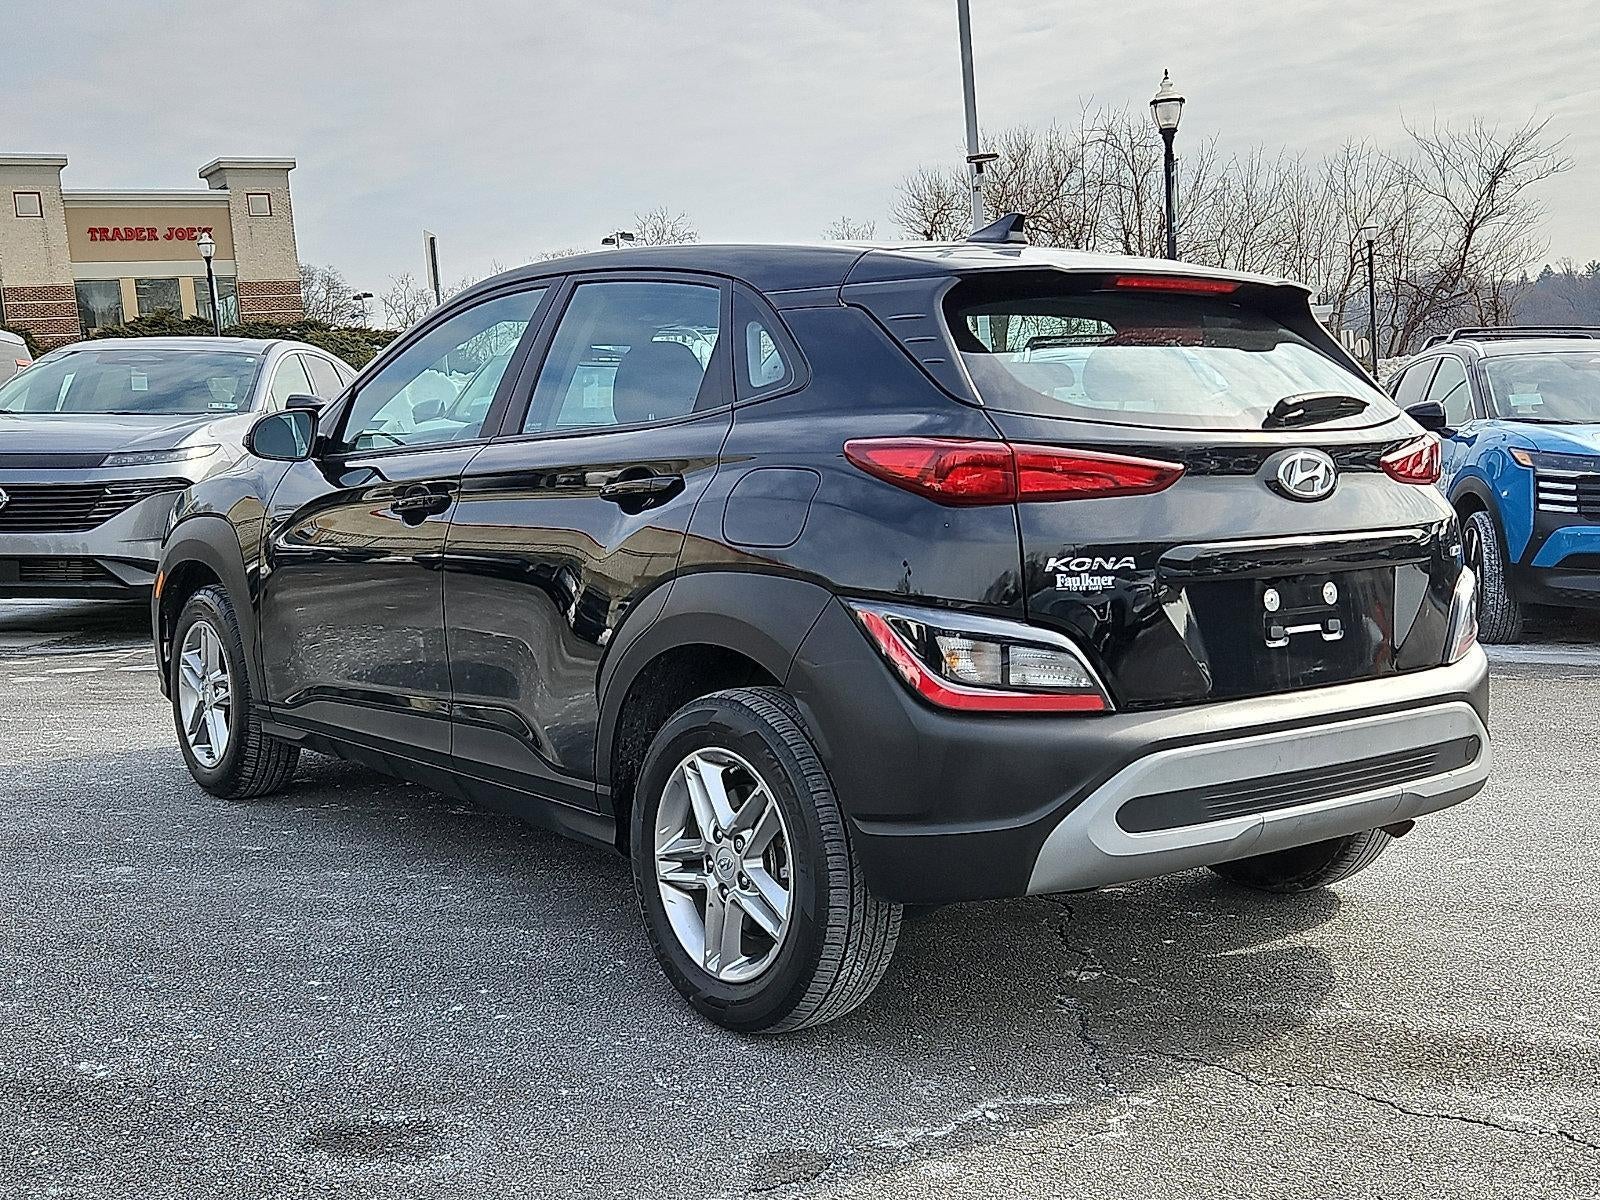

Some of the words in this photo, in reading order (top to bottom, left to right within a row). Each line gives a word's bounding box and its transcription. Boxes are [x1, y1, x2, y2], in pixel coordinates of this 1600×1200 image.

[87, 226, 159, 241] TRADER
[1044, 557, 1136, 572] KONA
[1055, 573, 1115, 588] Faulkner
